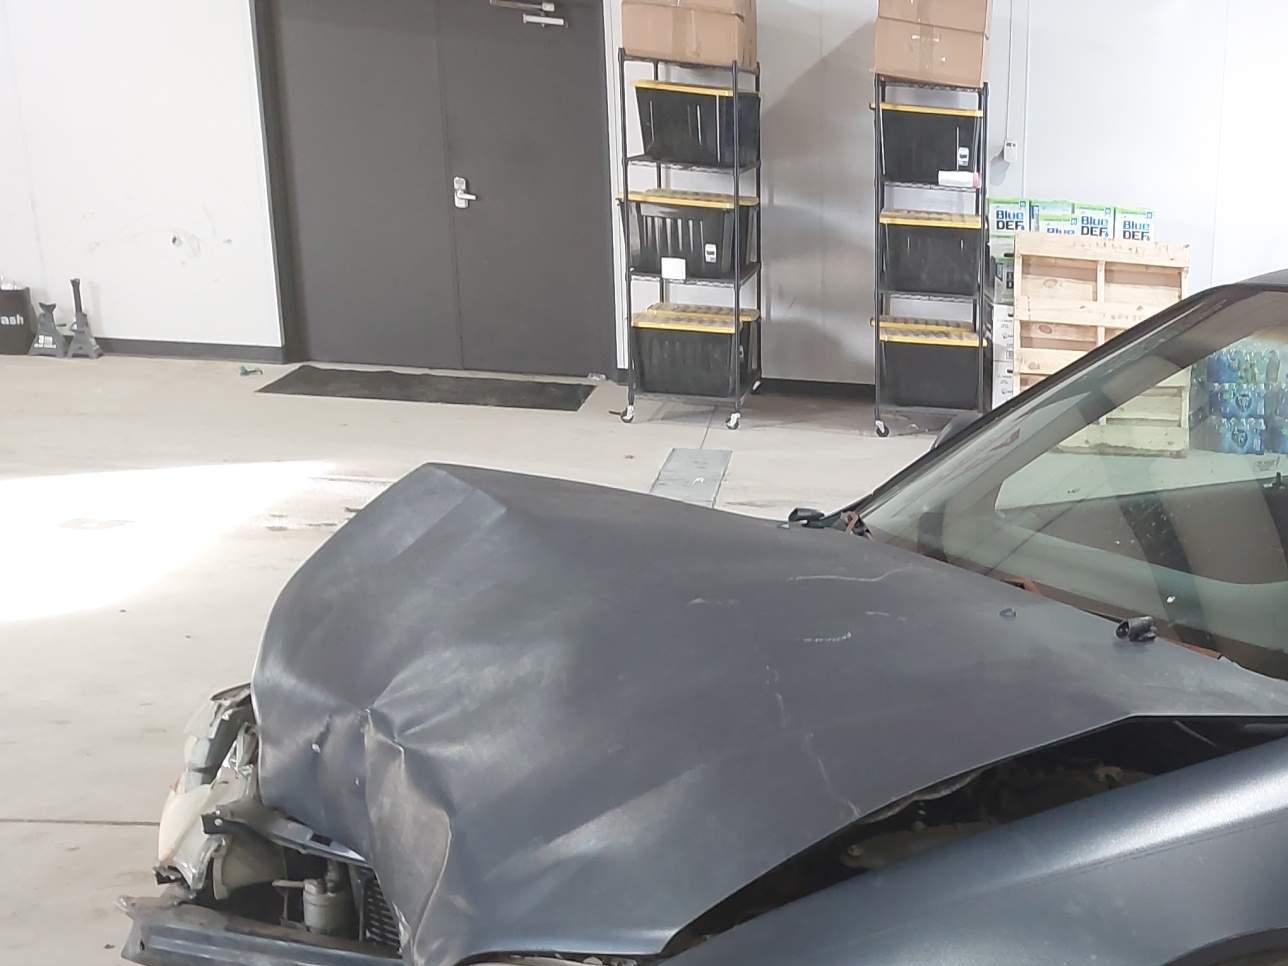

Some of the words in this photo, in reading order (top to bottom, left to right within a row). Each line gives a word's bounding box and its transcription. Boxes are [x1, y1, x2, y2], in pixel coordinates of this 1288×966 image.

[996, 210, 1024, 220] Blue
[1081, 215, 1109, 226] Blue
[996, 220, 1024, 231] DEF
[1123, 220, 1150, 231] Blue
[1081, 226, 1108, 237] DEF
[1123, 230, 1150, 241] DEF
[0, 313, 25, 326] ash
